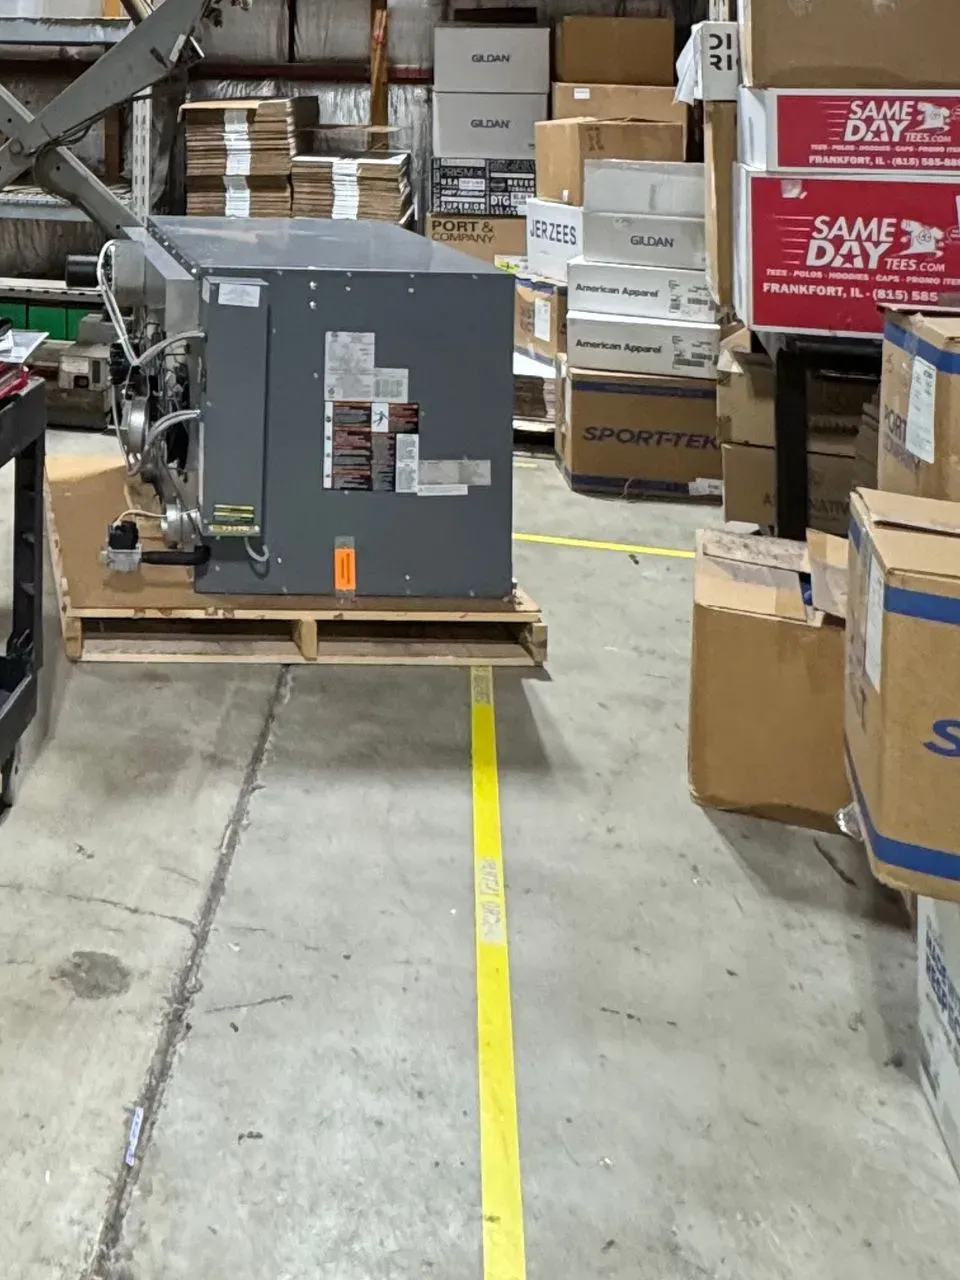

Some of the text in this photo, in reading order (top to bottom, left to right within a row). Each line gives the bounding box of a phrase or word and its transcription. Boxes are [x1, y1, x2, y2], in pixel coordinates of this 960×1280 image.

[709, 33, 732, 51] DI
[471, 53, 511, 64] GILDAN
[709, 53, 737, 71] RI
[848, 100, 915, 121] SAME
[470, 119, 510, 130] GILDAN
[844, 120, 908, 142] DAY
[491, 196, 510, 205] DTG
[432, 221, 494, 232] PORT &
[530, 220, 577, 245] JERZEES
[811, 216, 897, 242] SAME
[431, 232, 496, 243] COMPANY
[630, 235, 674, 247] GILDAN
[806, 239, 892, 269] DAY
[575, 283, 659, 298] American Apparel
[763, 283, 938, 301] FRANKFORT, IL (815) 585
[575, 339, 661, 354] American Apparel
[582, 426, 719, 449] SPORT-TEK
